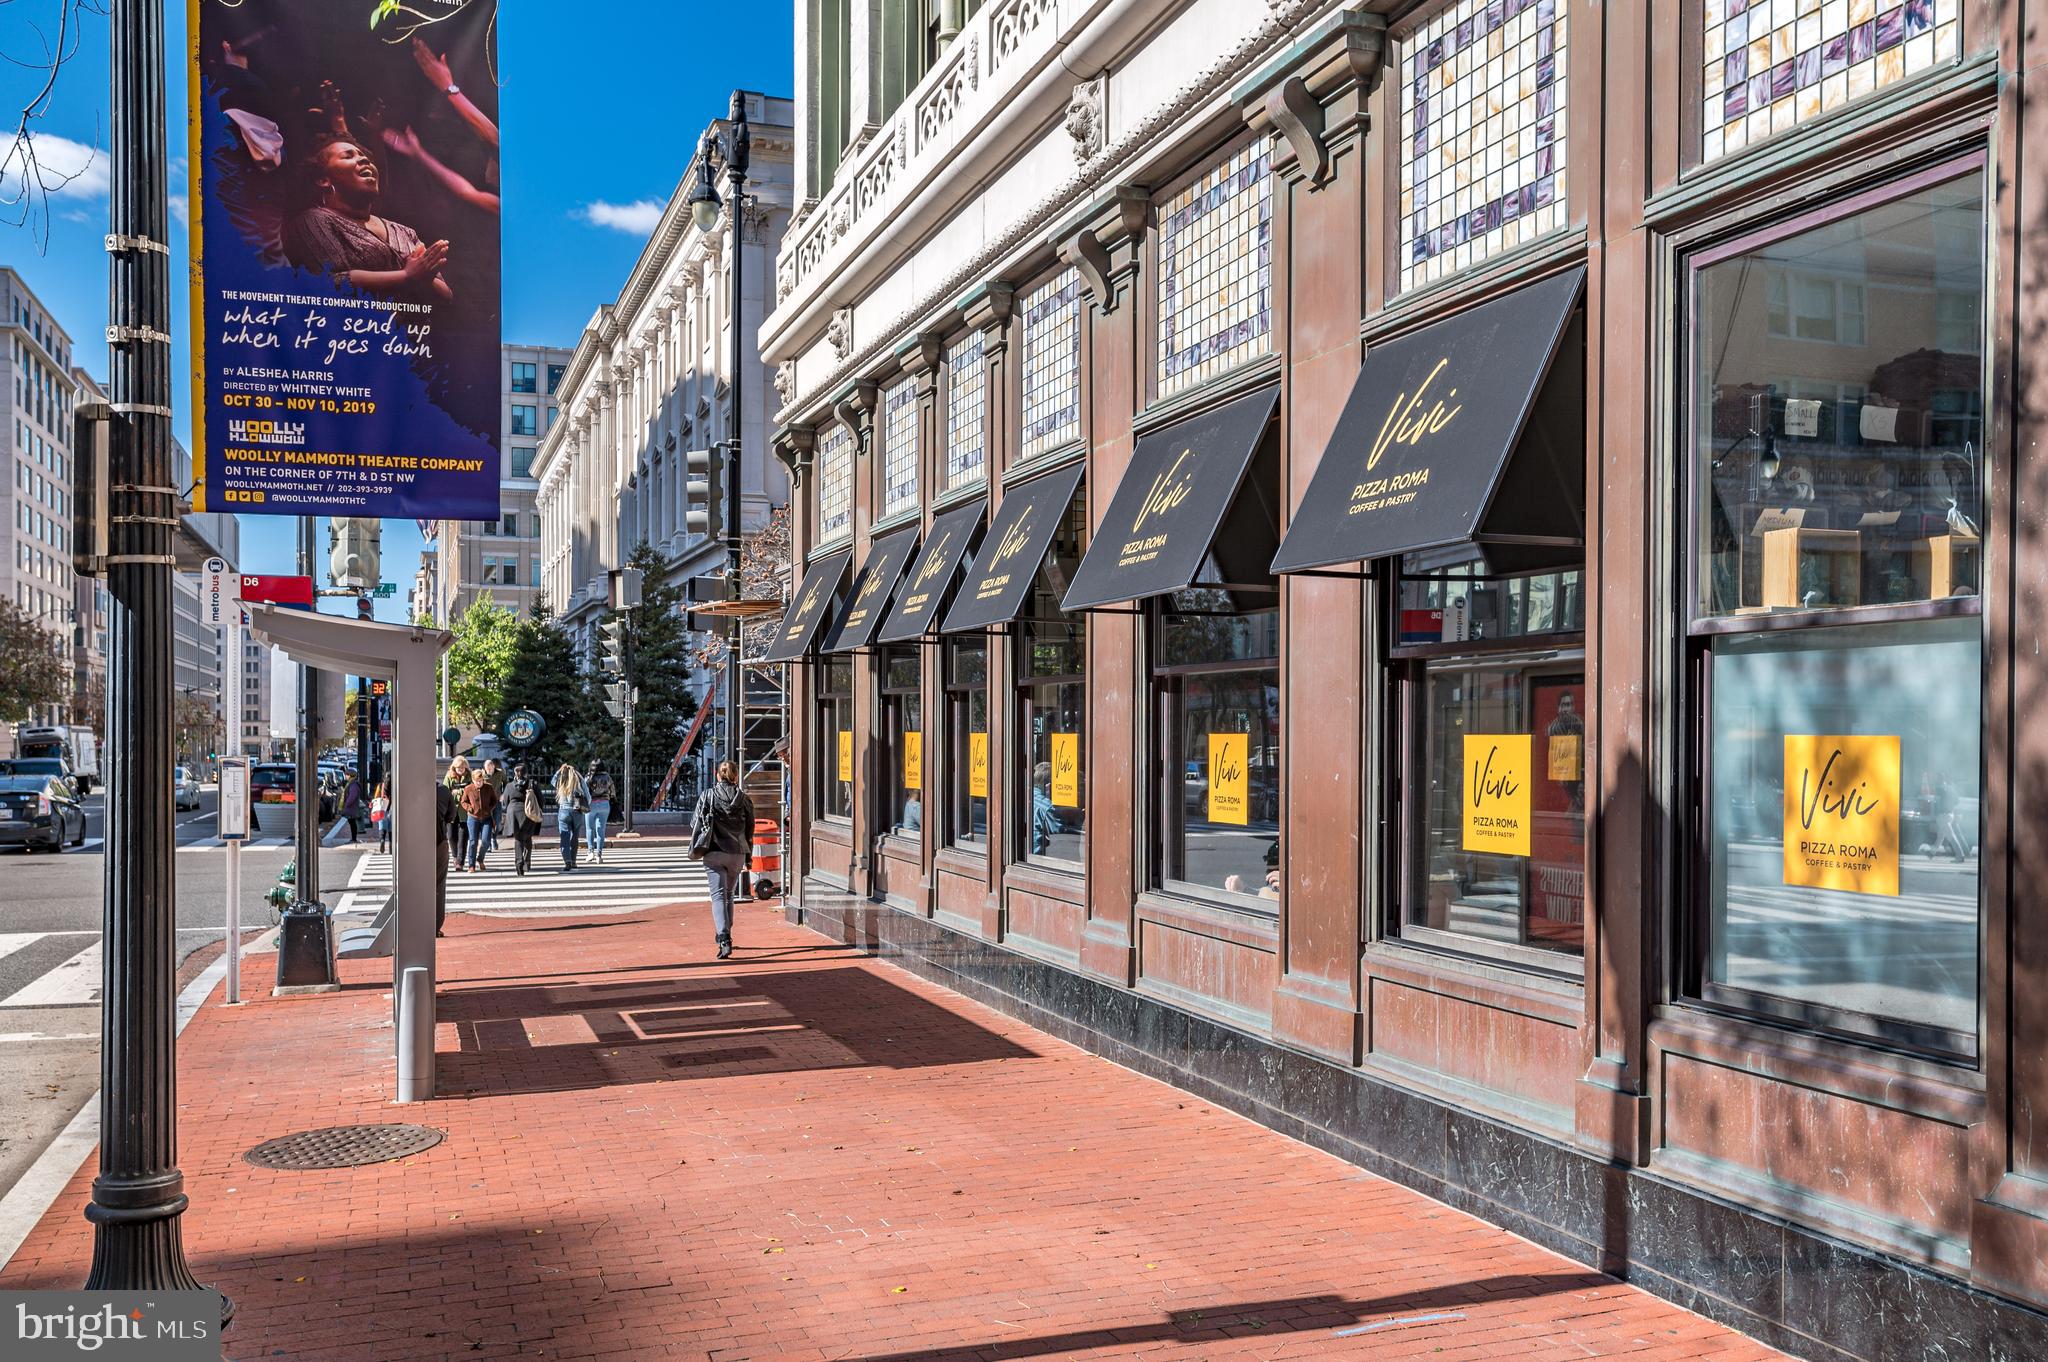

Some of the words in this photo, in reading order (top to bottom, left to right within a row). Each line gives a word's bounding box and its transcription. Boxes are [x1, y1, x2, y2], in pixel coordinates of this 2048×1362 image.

[222, 290, 238, 300] THE
[239, 292, 284, 303] MOVEMENT
[286, 295, 321, 306] THEATRE
[323, 297, 369, 309] COMPANY'S
[371, 301, 420, 312] PRODUCTION
[422, 304, 433, 314] OF
[224, 306, 287, 326] what
[304, 310, 326, 328] to
[343, 311, 397, 334] send
[407, 324, 430, 343] up
[222, 325, 280, 348] when
[295, 330, 318, 349] it
[324, 339, 369, 365] goes
[382, 335, 433, 358] down
[223, 367, 234, 376] BY
[236, 366, 290, 379] ALESHEA
[292, 369, 334, 381] HARRIS
[223, 381, 266, 392] DIRECTED
[268, 383, 279, 392] BY
[281, 383, 332, 395] WHITNEY
[335, 386, 371, 397] WHITE
[224, 394, 252, 407] OCT
[255, 396, 272, 408] 30
[287, 398, 316, 411] NOV
[319, 400, 340, 414] 10,
[343, 401, 376, 414] 2019
[1367, 358, 1462, 471] Vivi
[229, 420, 304, 436] WOOLLY
[224, 448, 281, 462] WOOLLY
[284, 451, 355, 466] MAMMOTH
[358, 454, 418, 468] THEATRE
[420, 458, 483, 471] COMPANY
[225, 466, 241, 476] ON
[244, 466, 267, 477] THE
[269, 467, 316, 479] CORNER
[318, 470, 333, 480] OF
[335, 471, 356, 481] 7TH
[359, 472, 368, 481] &
[370, 472, 378, 482] D
[380, 473, 394, 482] ST
[396, 474, 415, 483] NW
[1351, 478, 1388, 500] PIZZA
[1389, 468, 1429, 492] ROMA
[225, 480, 323, 492] WOOLLYMAMMOTH.NET
[338, 485, 392, 494] 202-393-3939
[1133, 449, 1192, 533] Vivi
[272, 494, 366, 505] @WOOLLYMAMMOTHTC
[1349, 500, 1379, 514] COFFEE
[1385, 491, 1417, 507] PASTRY
[1121, 540, 1144, 556] PIZZA
[1143, 533, 1168, 550] ROMA
[243, 577, 259, 586] D6
[210, 575, 220, 621] metrobus
[373, 683, 385, 694] 32
[1056, 740, 1073, 779] Vivi
[1214, 742, 1240, 789] Vivi
[1473, 745, 1519, 808] Vivi
[1801, 749, 1879, 830] Vivi
[1473, 816, 1494, 828] PIZZA
[1496, 818, 1519, 829] ROMA
[1476, 829, 1493, 837] COFFEE
[1498, 831, 1515, 839] PASTRY
[1800, 841, 1835, 856] PIZZA
[1839, 844, 1878, 860] ROMA
[1805, 858, 1834, 868] COFFEE
[1843, 861, 1872, 872] PASTRY
